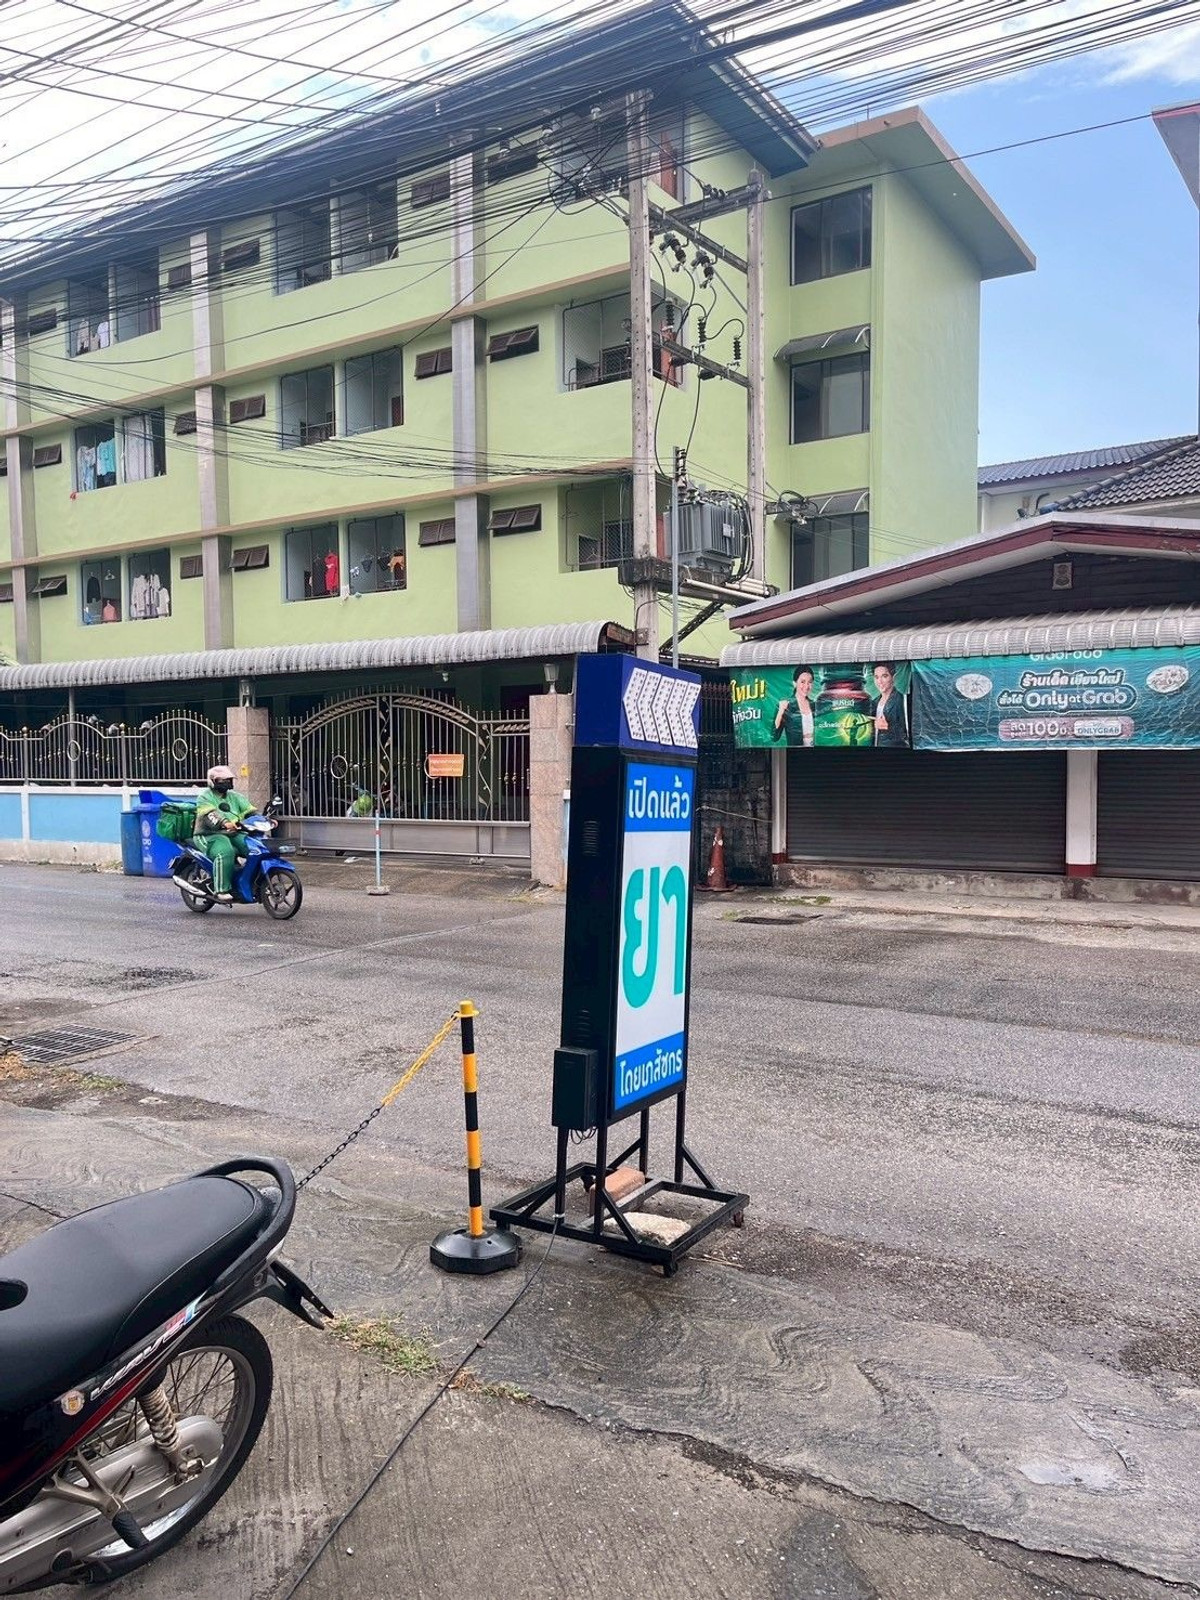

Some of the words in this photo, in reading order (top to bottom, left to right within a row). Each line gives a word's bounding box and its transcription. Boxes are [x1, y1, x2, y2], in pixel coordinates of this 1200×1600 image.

[730, 678, 766, 704] ใหม่!
[1026, 690, 1068, 709] Only
[1069, 694, 1081, 703] at
[1082, 688, 1128, 705] Grab
[1077, 726, 1119, 735] ONLYGRAB
[628, 775, 690, 819] เปิดแล้ว
[622, 865, 686, 1008] ยา
[619, 1048, 683, 1097] โดยเภสัชกร
